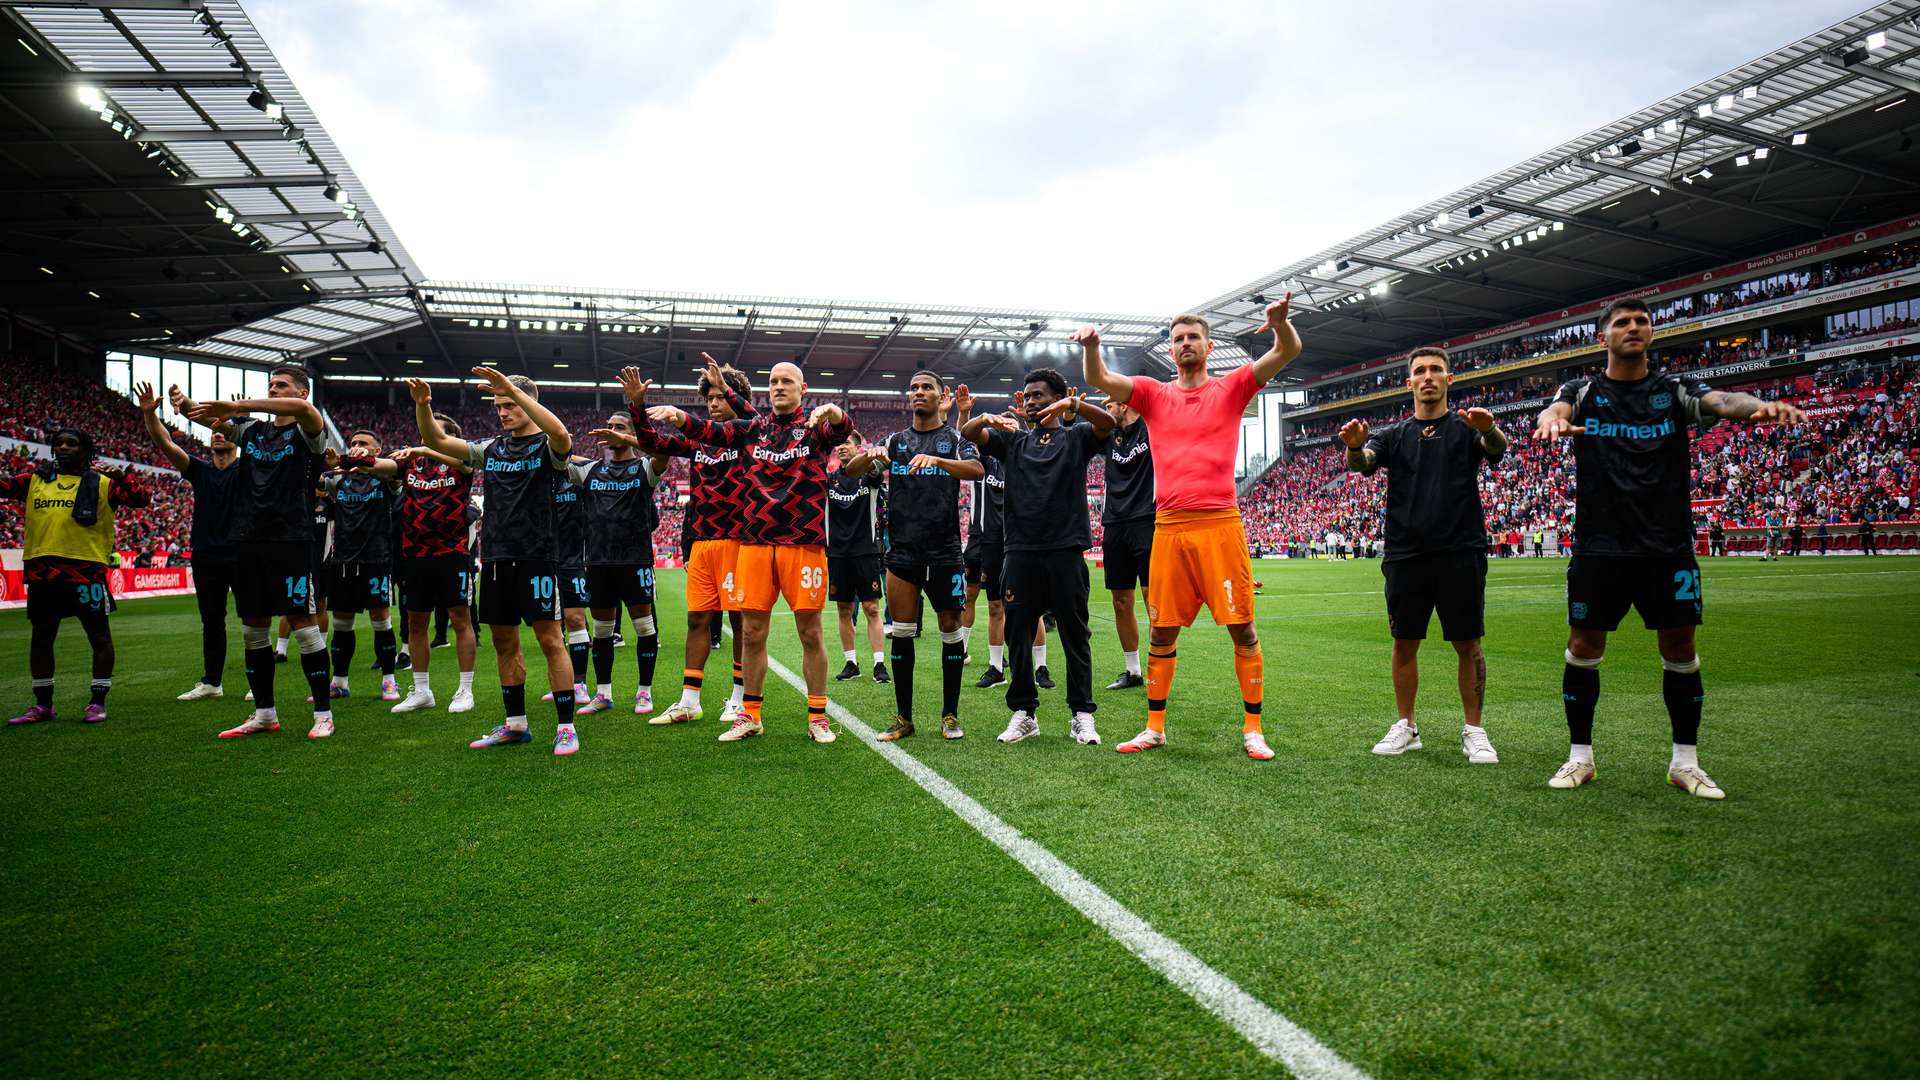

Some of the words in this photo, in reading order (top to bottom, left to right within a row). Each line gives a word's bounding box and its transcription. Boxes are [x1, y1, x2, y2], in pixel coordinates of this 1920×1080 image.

[1776, 252, 1794, 264] Dich
[1715, 361, 1771, 378] STADTWERKE
[752, 444, 810, 462] Barmenia
[485, 456, 542, 473] Barmenia
[135, 573, 180, 590] GAMESRIGHT
[286, 575, 308, 598] 14
[369, 576, 389, 595] 24
[458, 571, 467, 590] 7
[530, 575, 553, 599] 10
[637, 567, 653, 588] 13
[721, 571, 735, 593] 4
[800, 565, 823, 590] 36
[952, 574, 965, 597] 2
[77, 583, 103, 604] 30
[1223, 578, 1233, 604] 1
